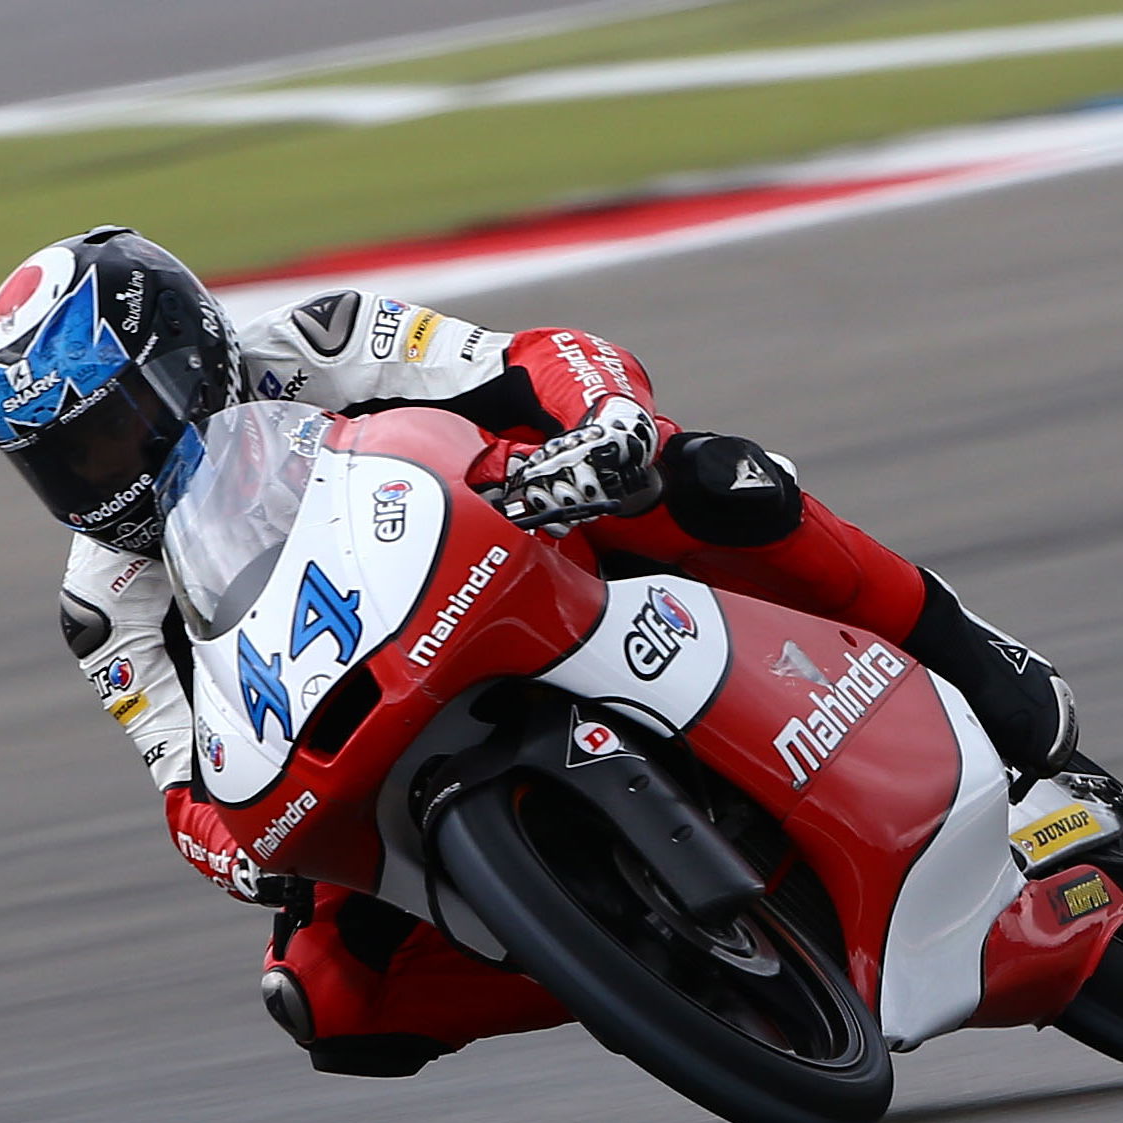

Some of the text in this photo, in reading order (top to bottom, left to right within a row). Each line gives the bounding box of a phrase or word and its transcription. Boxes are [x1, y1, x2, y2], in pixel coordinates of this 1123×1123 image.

[1, 370, 62, 413] SHARK
[279, 368, 309, 401] ARK
[81, 473, 154, 525] vodafone
[237, 559, 364, 743] 44
[624, 601, 683, 682] elf
[88, 664, 114, 700] lf
[583, 726, 611, 753] D
[1033, 810, 1090, 847] DUNLOP
